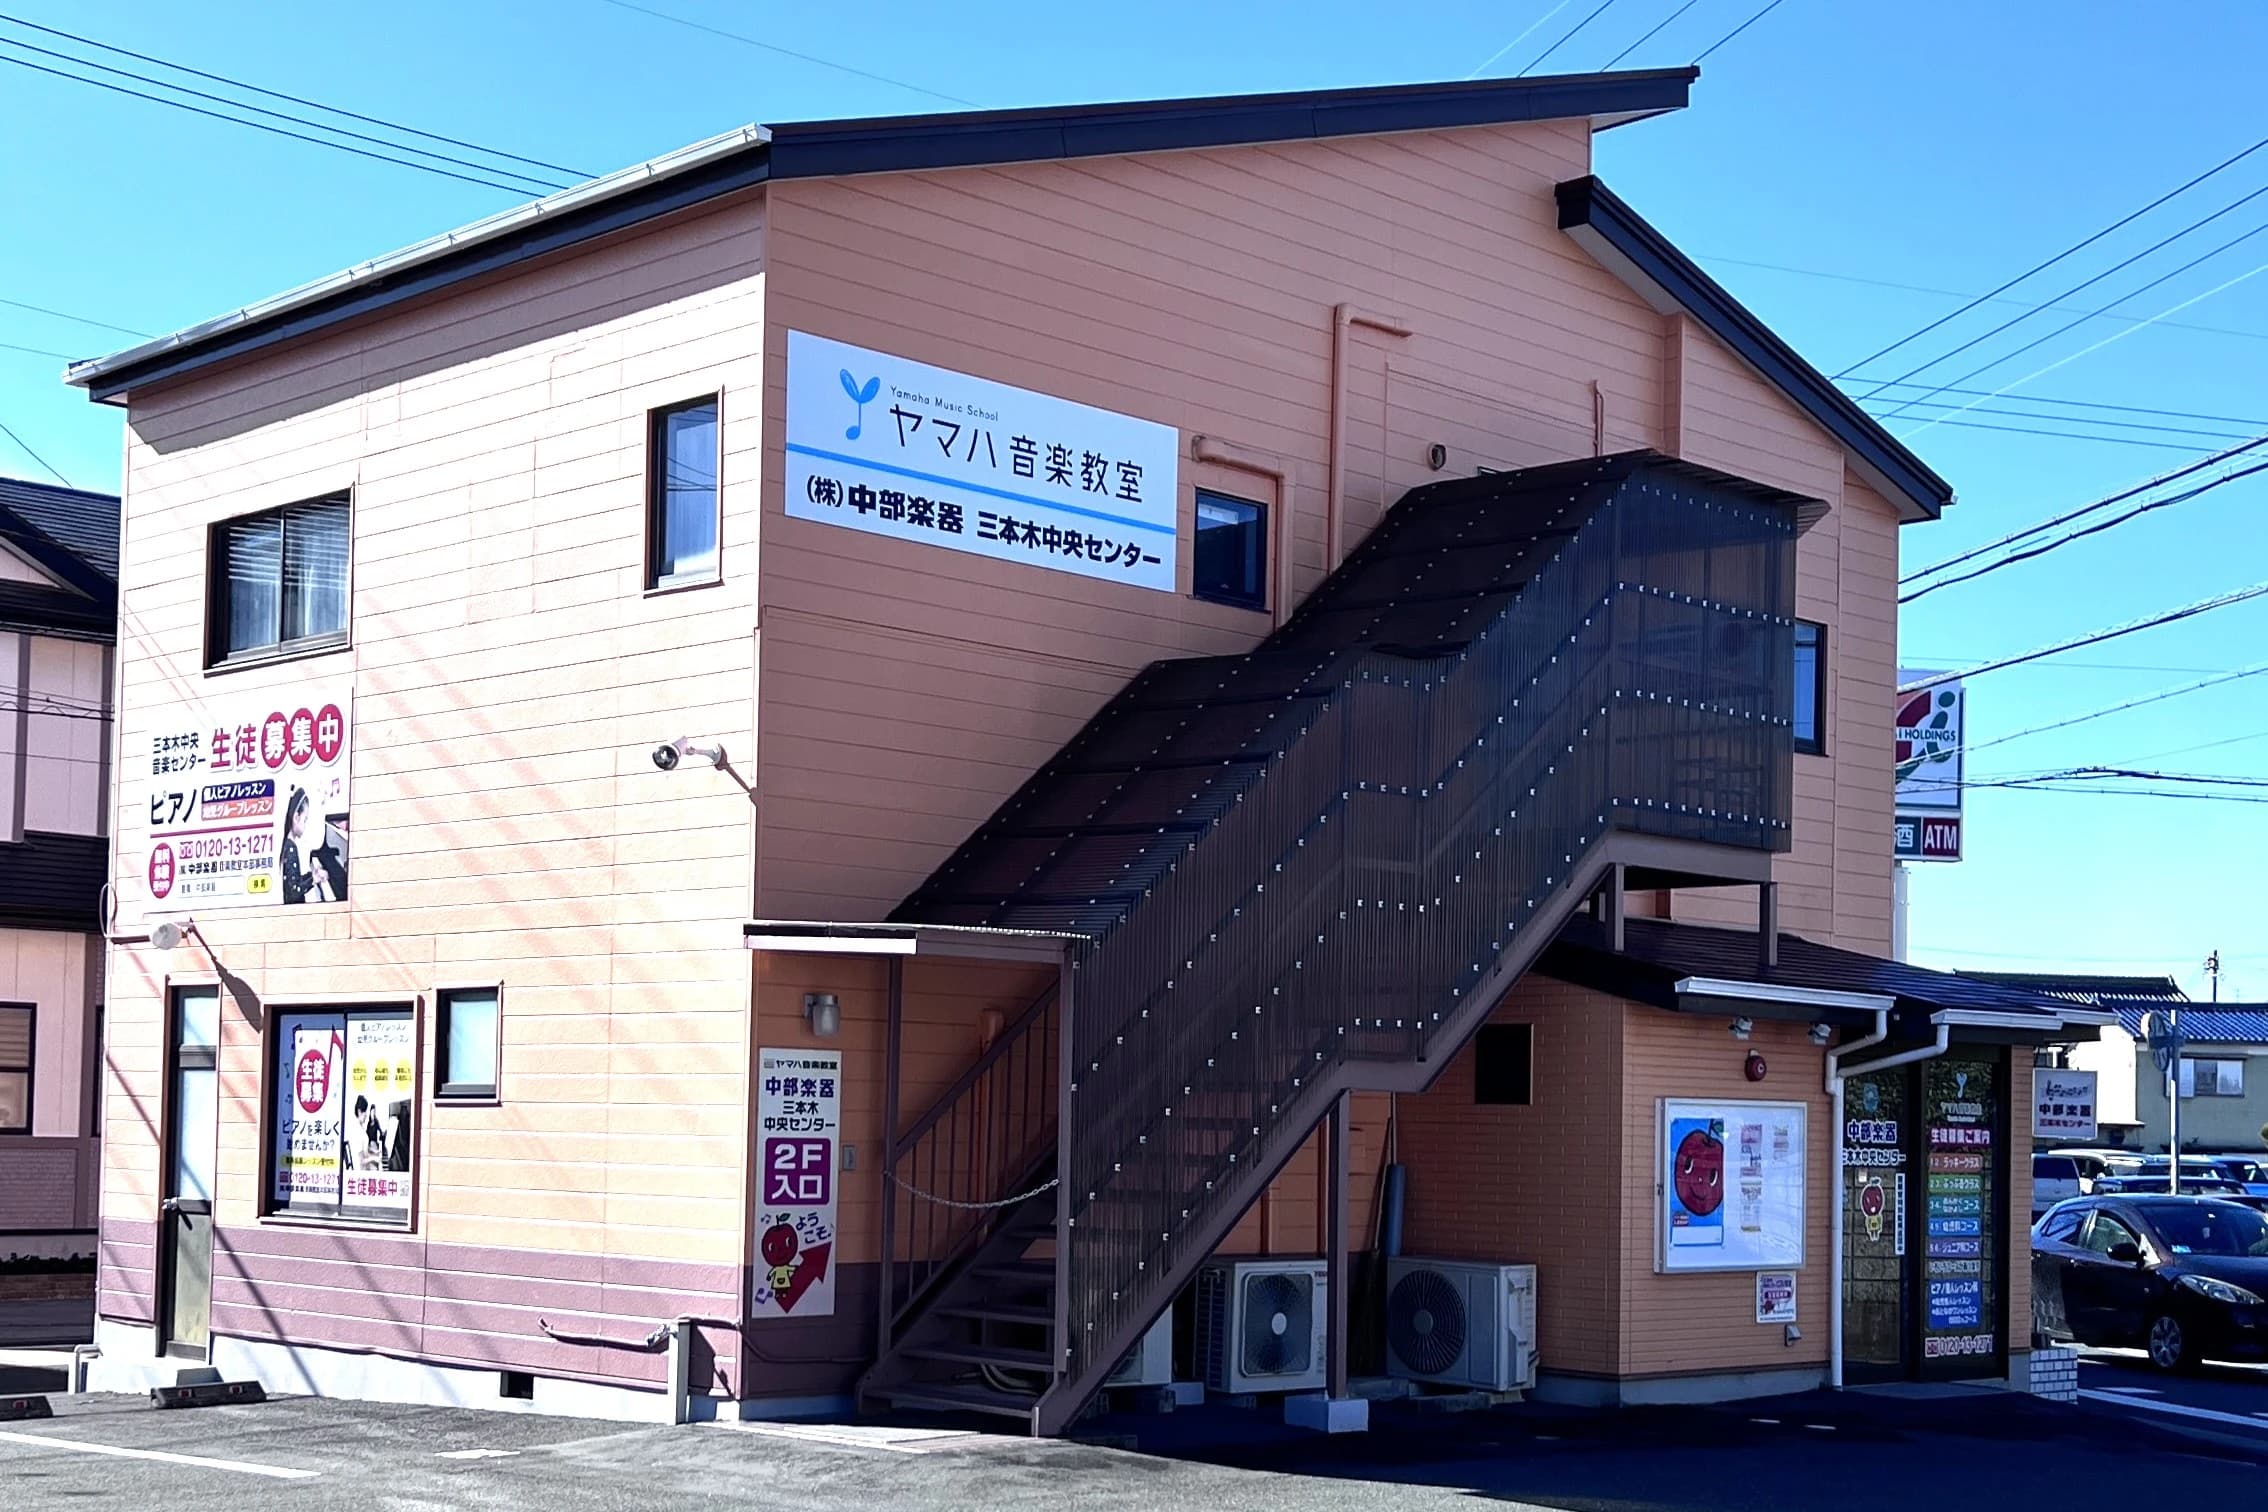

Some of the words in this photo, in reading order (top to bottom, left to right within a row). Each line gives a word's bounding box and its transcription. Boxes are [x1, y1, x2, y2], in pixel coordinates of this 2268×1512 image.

[890, 385, 930, 405] Yamaha
[935, 396, 963, 413] Music
[967, 404, 999, 422] School
[889, 403, 1143, 503] ヤマハ音楽教室
[977, 510, 1162, 568] 三本木中央センター
[153, 732, 200, 754] 三本木中央
[210, 708, 341, 769] 生徒募集中
[1905, 729, 1956, 741] HOLDINGS
[153, 754, 206, 775] 音楽センター
[151, 789, 197, 825] ピアノ
[196, 834, 273, 858] 0120-13-1271
[1924, 825, 1957, 850] ATM
[301, 1059, 325, 1080] 生徒
[776, 1060, 838, 1070] ヤマハ音楽教室
[766, 1076, 834, 1098] 中部楽器
[783, 1101, 819, 1115] 三本木
[2039, 1104, 2091, 1117] 中部楽器
[282, 1120, 339, 1137] ピアノを楽しく
[764, 1116, 835, 1132] 中央センター
[1847, 1120, 1897, 1143] 中部楽器
[774, 1143, 824, 1170] 2F
[347, 1178, 397, 1197] 生徒募集中
[771, 1174, 823, 1200] 入口
